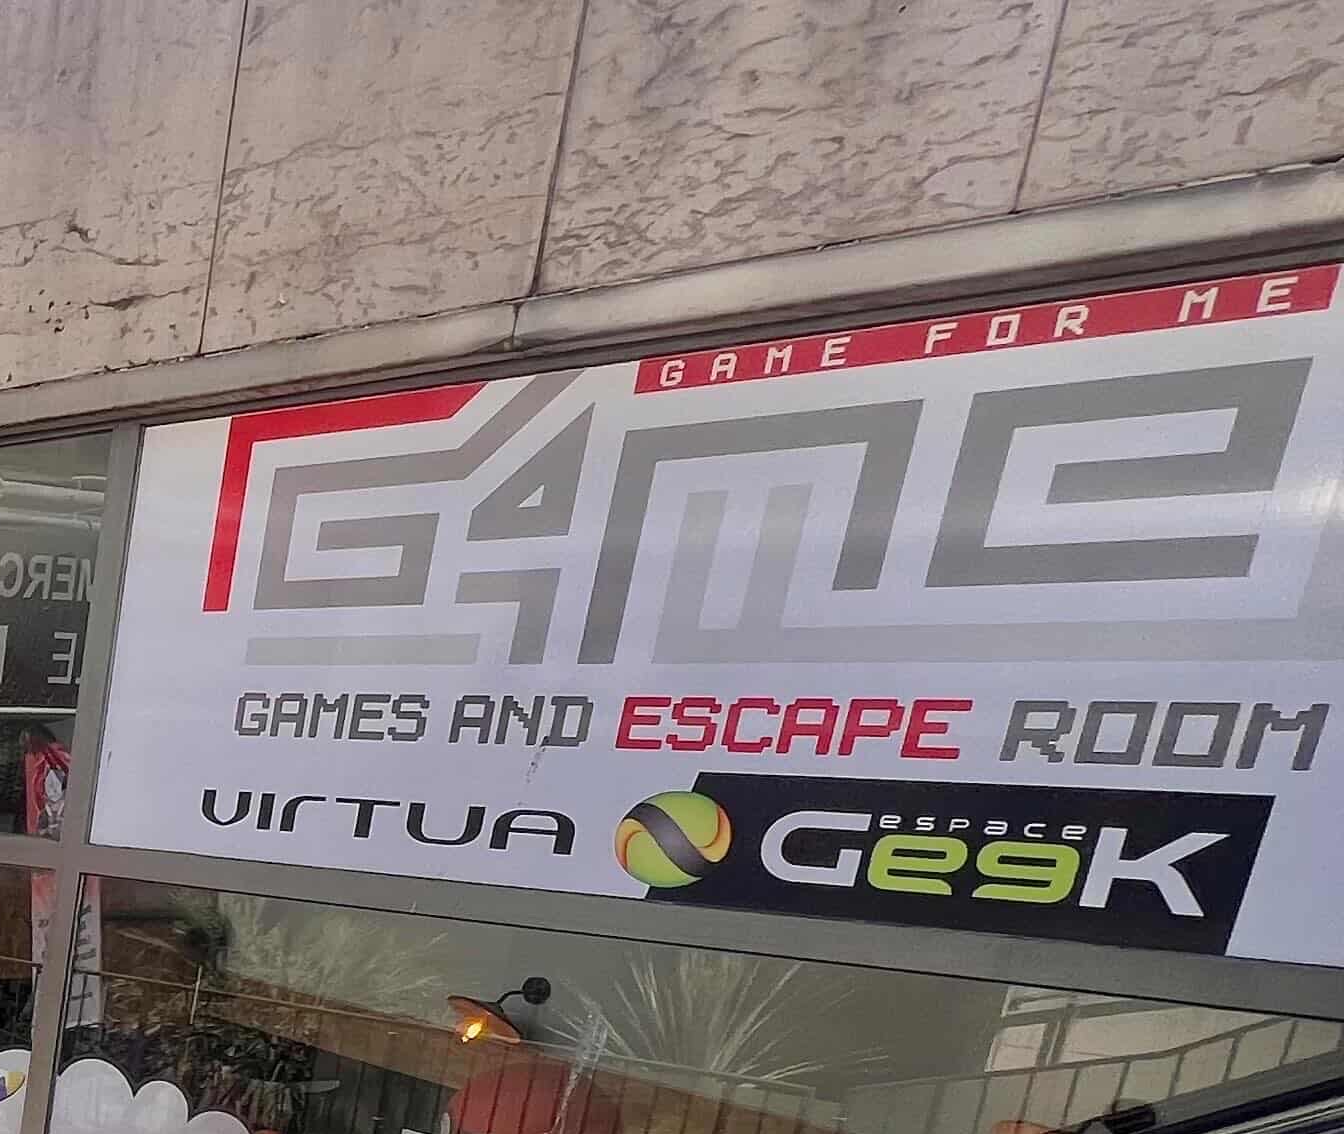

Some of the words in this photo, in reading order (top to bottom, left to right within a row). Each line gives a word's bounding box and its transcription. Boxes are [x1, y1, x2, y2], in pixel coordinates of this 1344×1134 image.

[659, 334, 850, 388] GAME
[923, 303, 1093, 355] FOR
[1177, 275, 1299, 323] ME
[234, 692, 431, 742] GAMES
[447, 694, 595, 749] AND
[614, 696, 974, 760] ESCAPE
[998, 699, 1332, 772] ROOM
[879, 814, 1087, 841] espace
